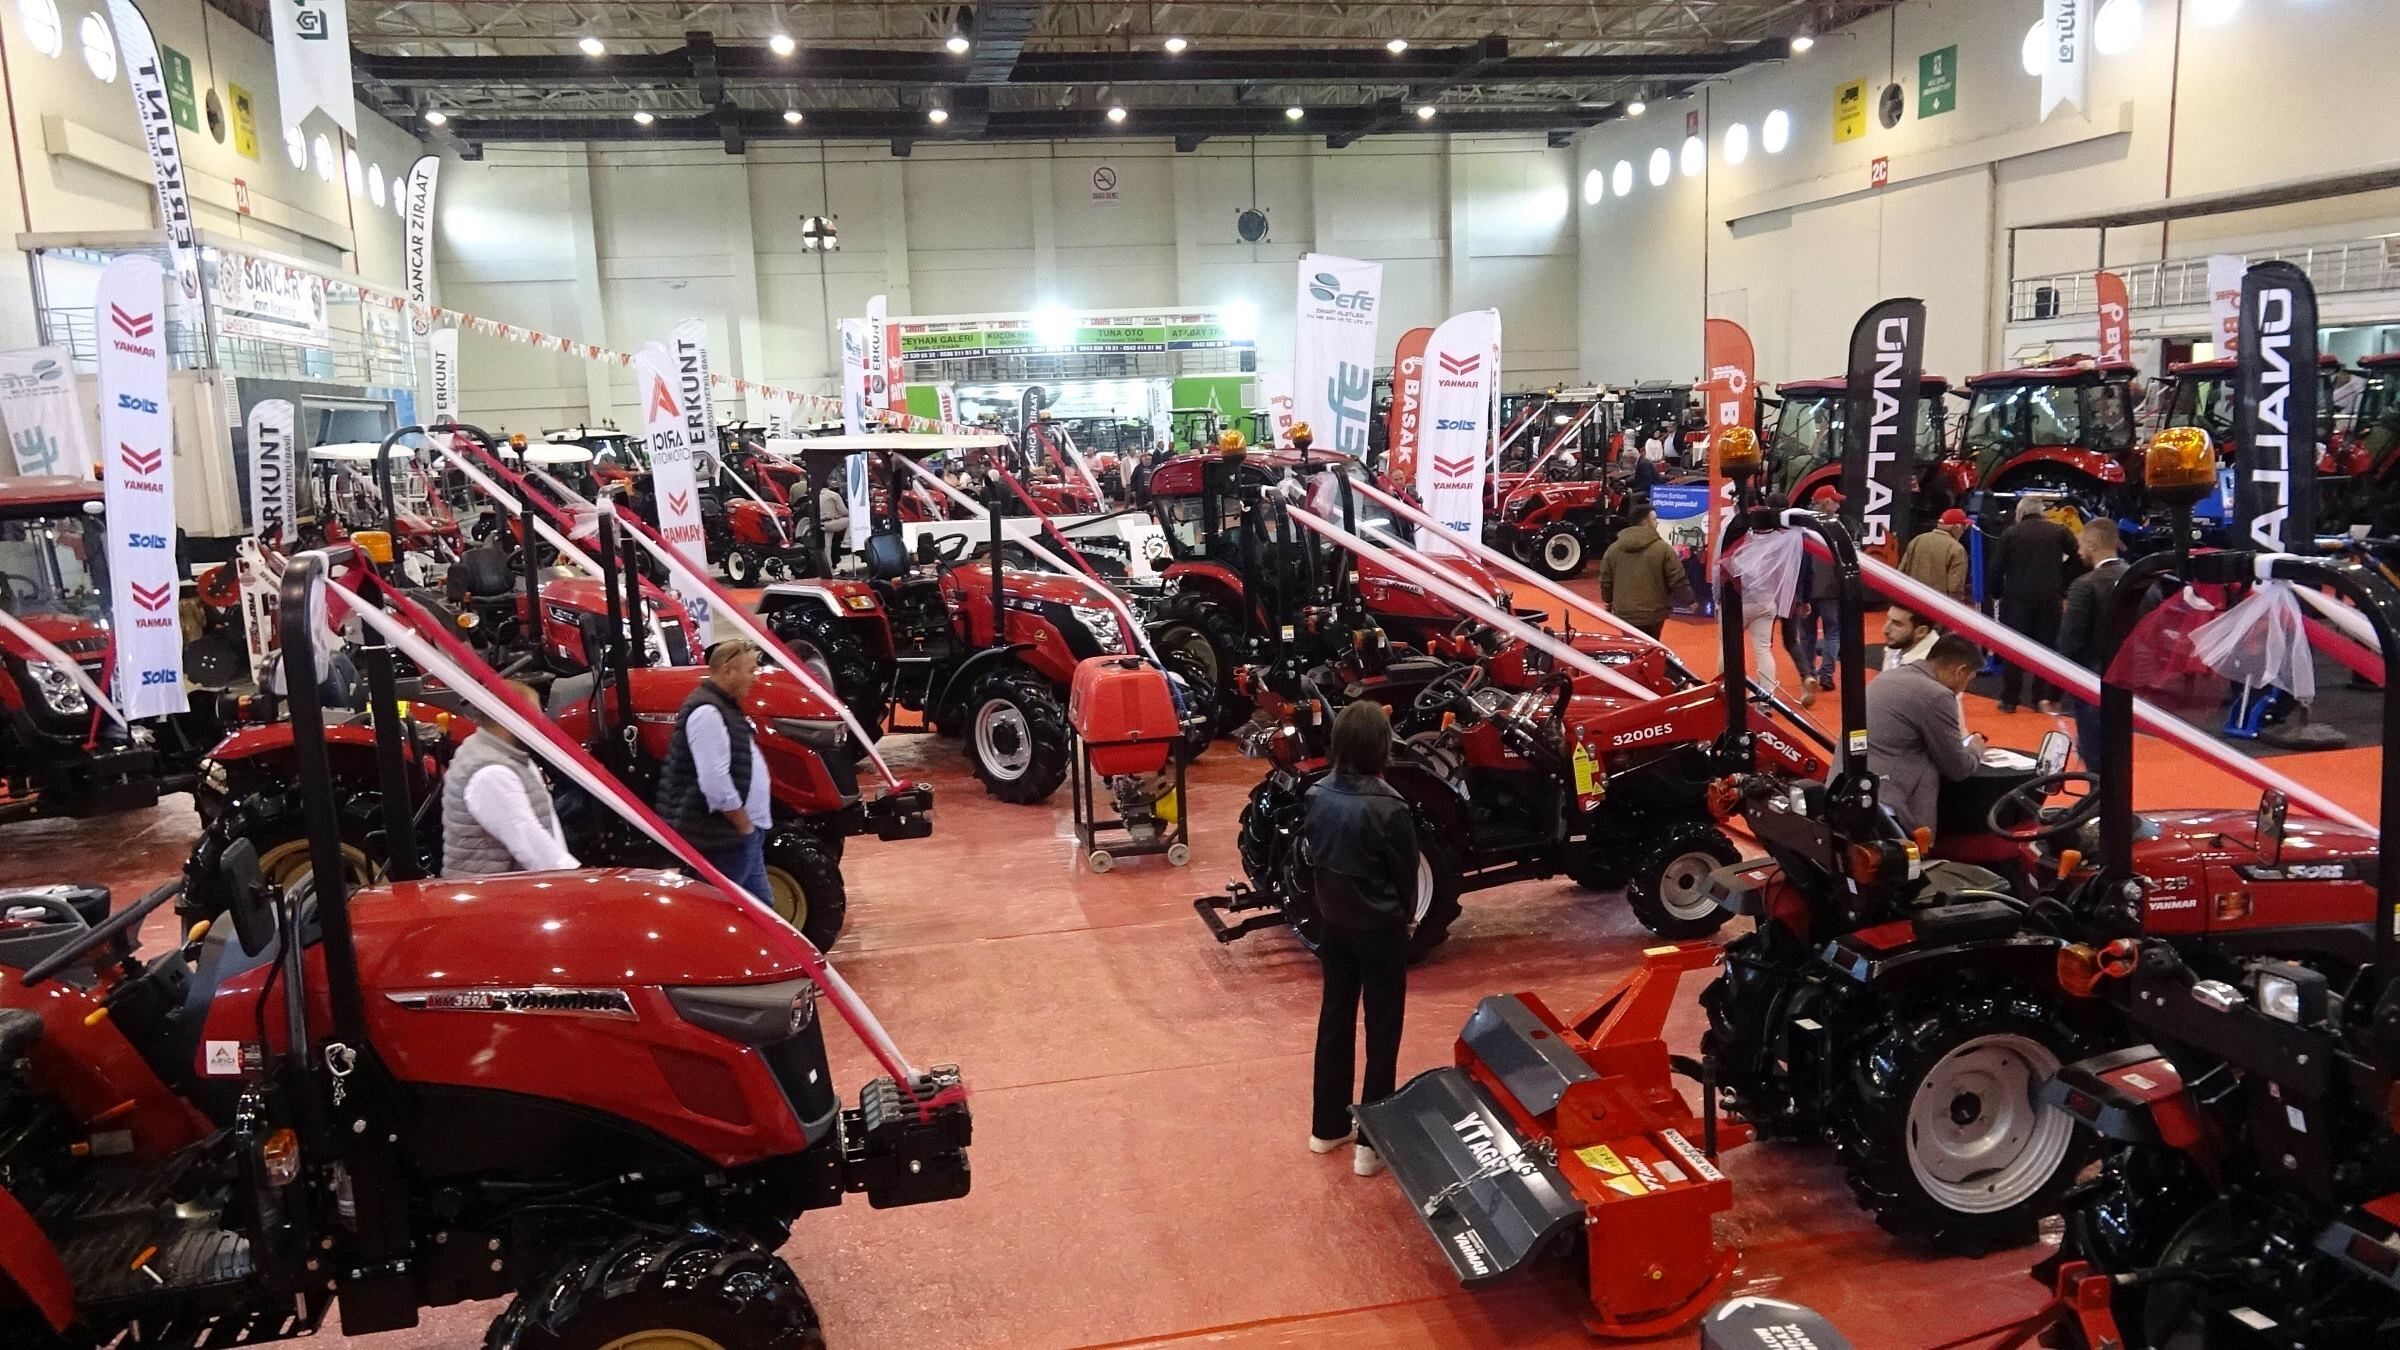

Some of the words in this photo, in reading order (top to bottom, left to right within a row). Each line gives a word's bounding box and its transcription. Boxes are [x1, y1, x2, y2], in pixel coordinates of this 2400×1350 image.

[1872, 161, 1888, 181] 2C
[412, 234, 426, 302] SANCAR
[1098, 329, 1122, 337] TUNA
[1124, 329, 1144, 337] OTO
[113, 340, 156, 358] YANMAR
[436, 350, 447, 411] ERKUNT
[1438, 379, 1478, 389] YANMAR
[678, 339, 706, 444] ERKUNT
[124, 480, 164, 493] YANMAR
[1434, 482, 1473, 491] YANMAR
[136, 618, 173, 628] YANMAR
[1613, 723, 1673, 746] 3200ES
[2149, 899, 2197, 911] YANMAR
[454, 994, 489, 1007] 359A
[1453, 1232, 1490, 1276] YANMAR
